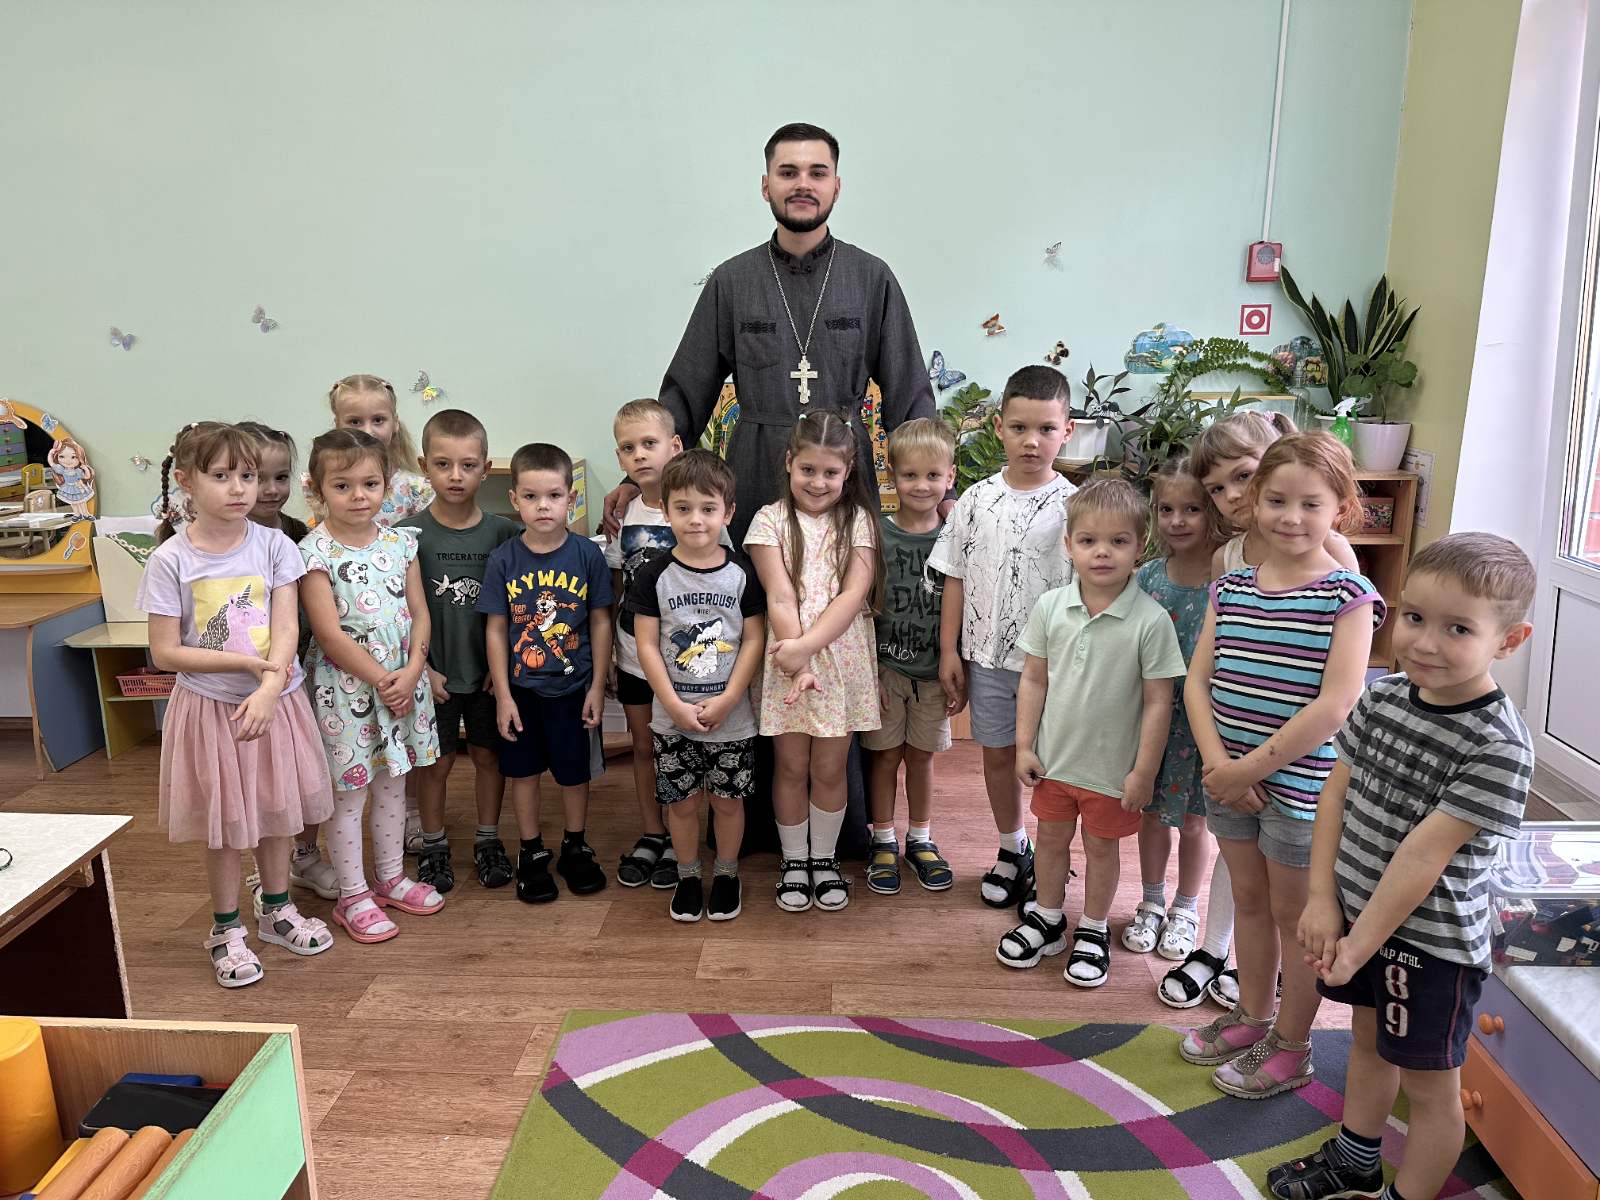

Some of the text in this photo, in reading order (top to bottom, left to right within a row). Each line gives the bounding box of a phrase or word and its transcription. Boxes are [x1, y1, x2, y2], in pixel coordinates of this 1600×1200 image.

[668, 592, 736, 611] DANGEROUS!
[879, 643, 918, 661] ENJOY
[1379, 945, 1423, 969] GAP ATHL.
[1384, 964, 1409, 1000] 8
[1385, 1002, 1408, 1037] 9
